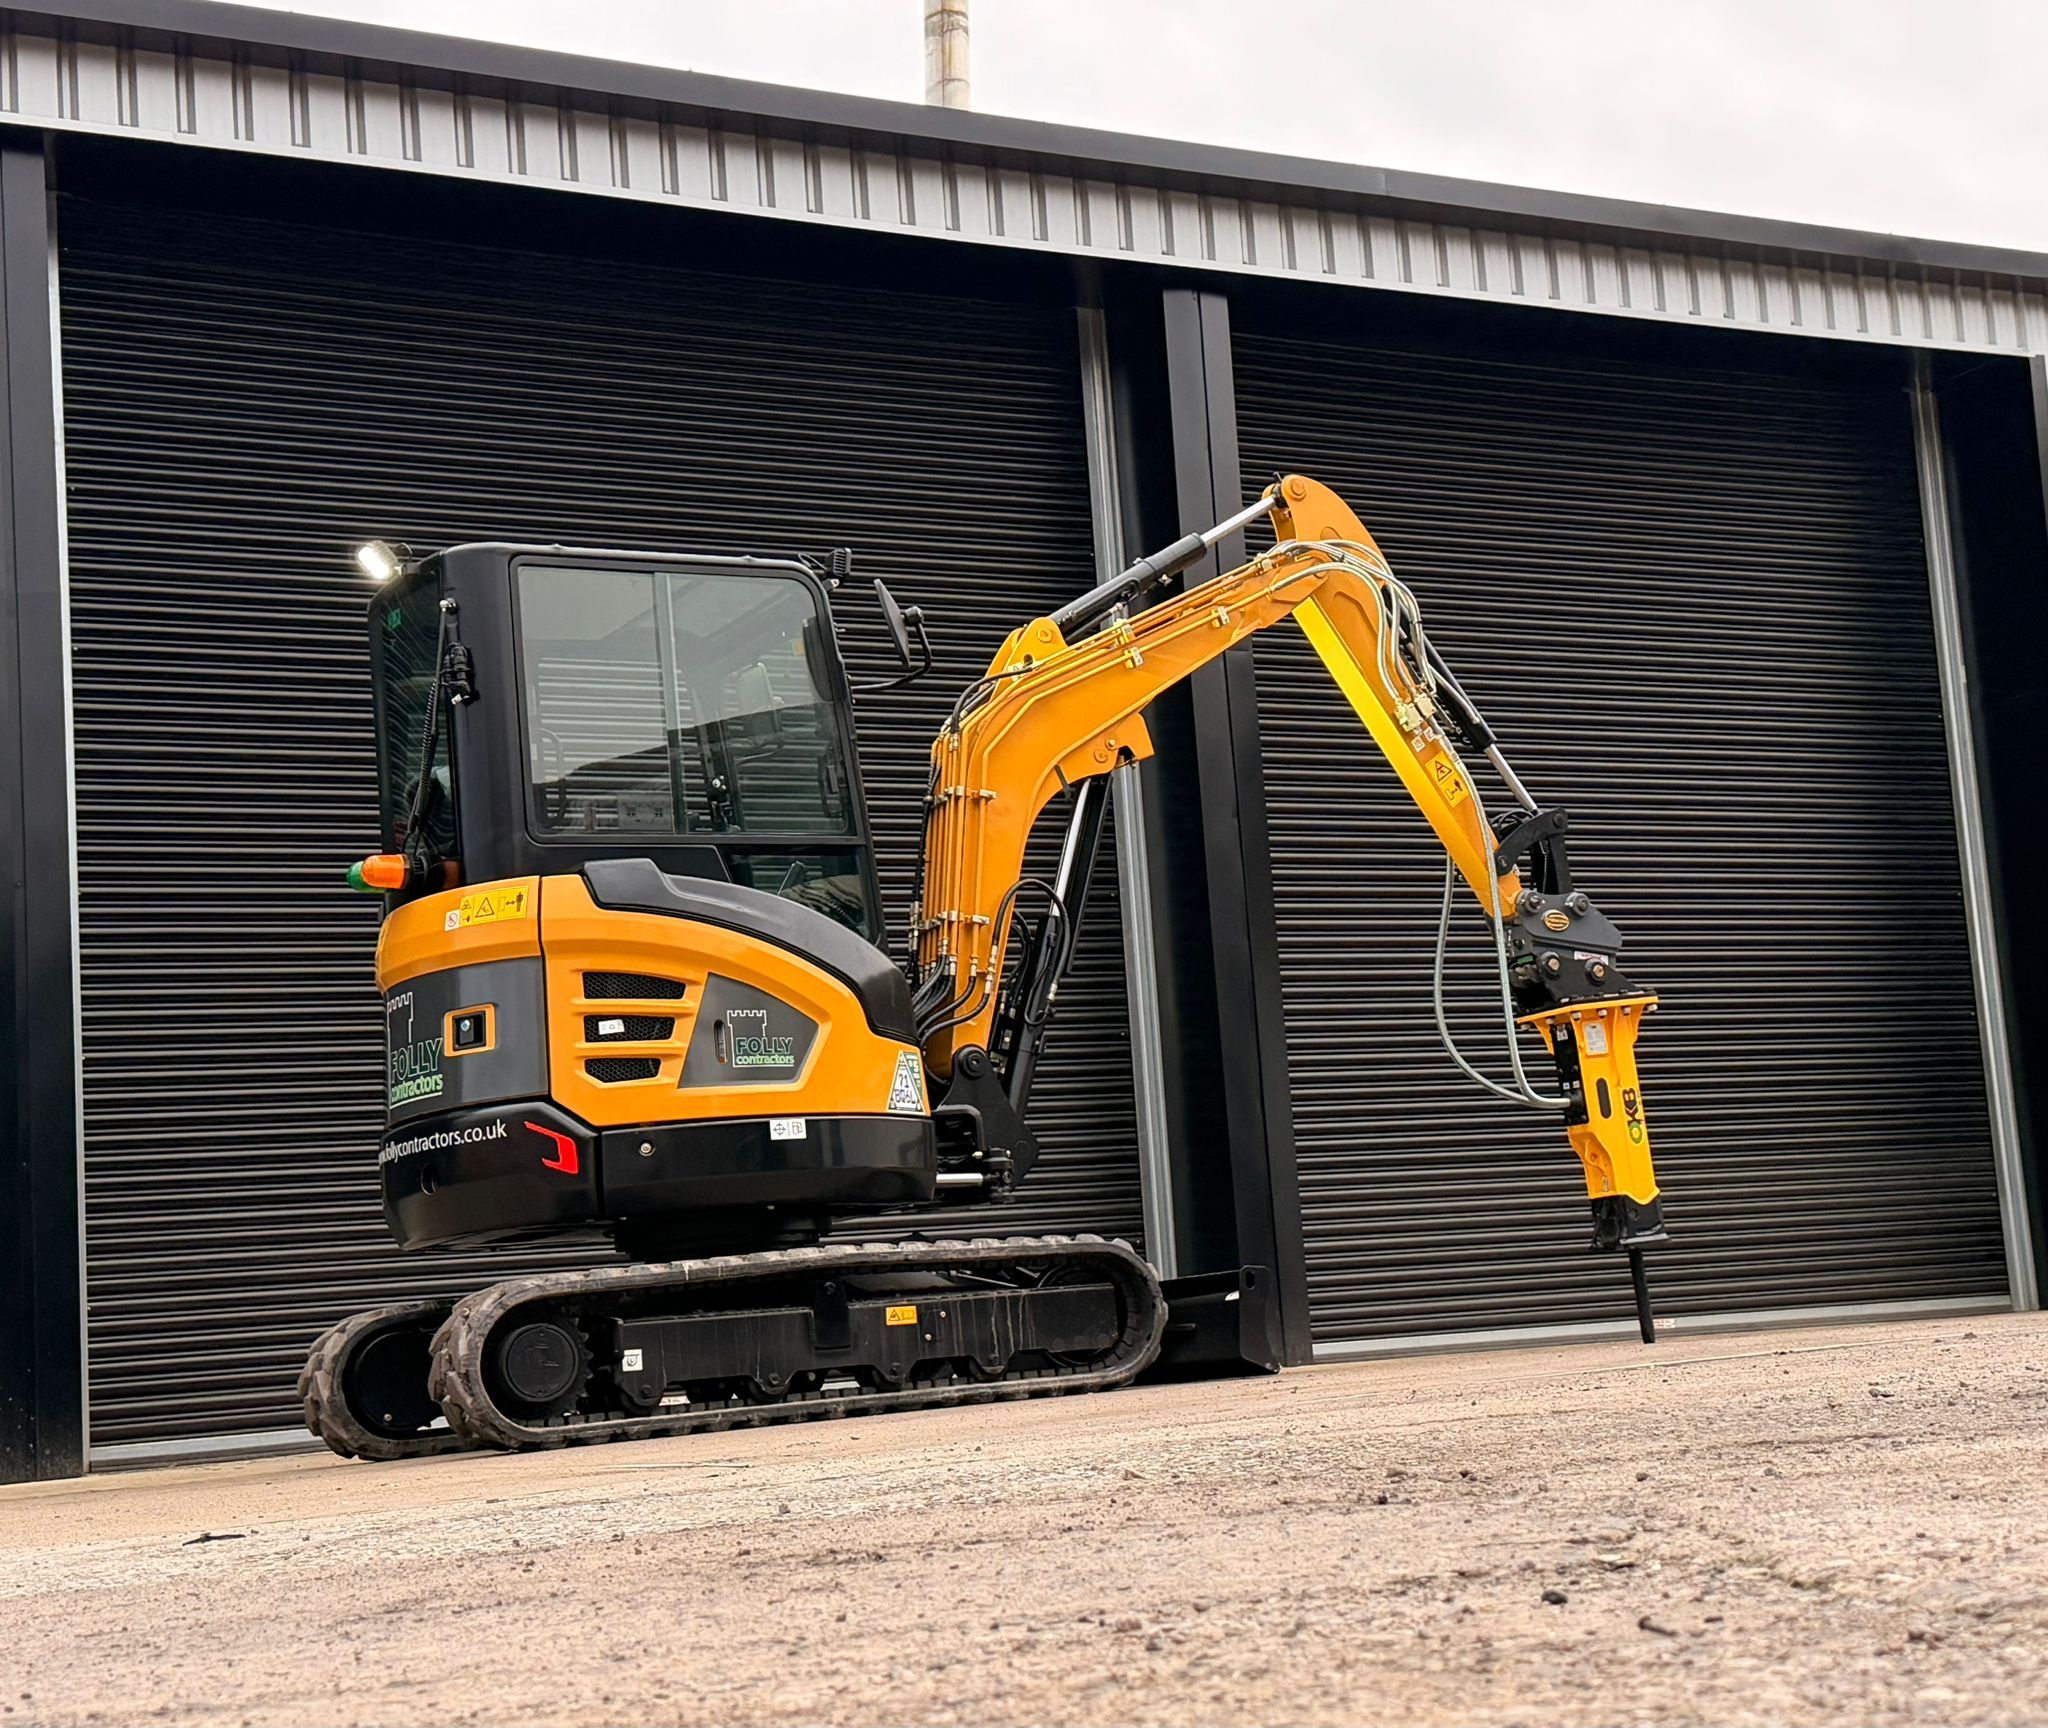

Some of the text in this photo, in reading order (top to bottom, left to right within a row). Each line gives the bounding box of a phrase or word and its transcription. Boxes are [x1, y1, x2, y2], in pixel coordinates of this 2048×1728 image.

[735, 1037, 793, 1055] FOLLY
[390, 1037, 443, 1084] FOLLY
[736, 1054, 795, 1065] contractors
